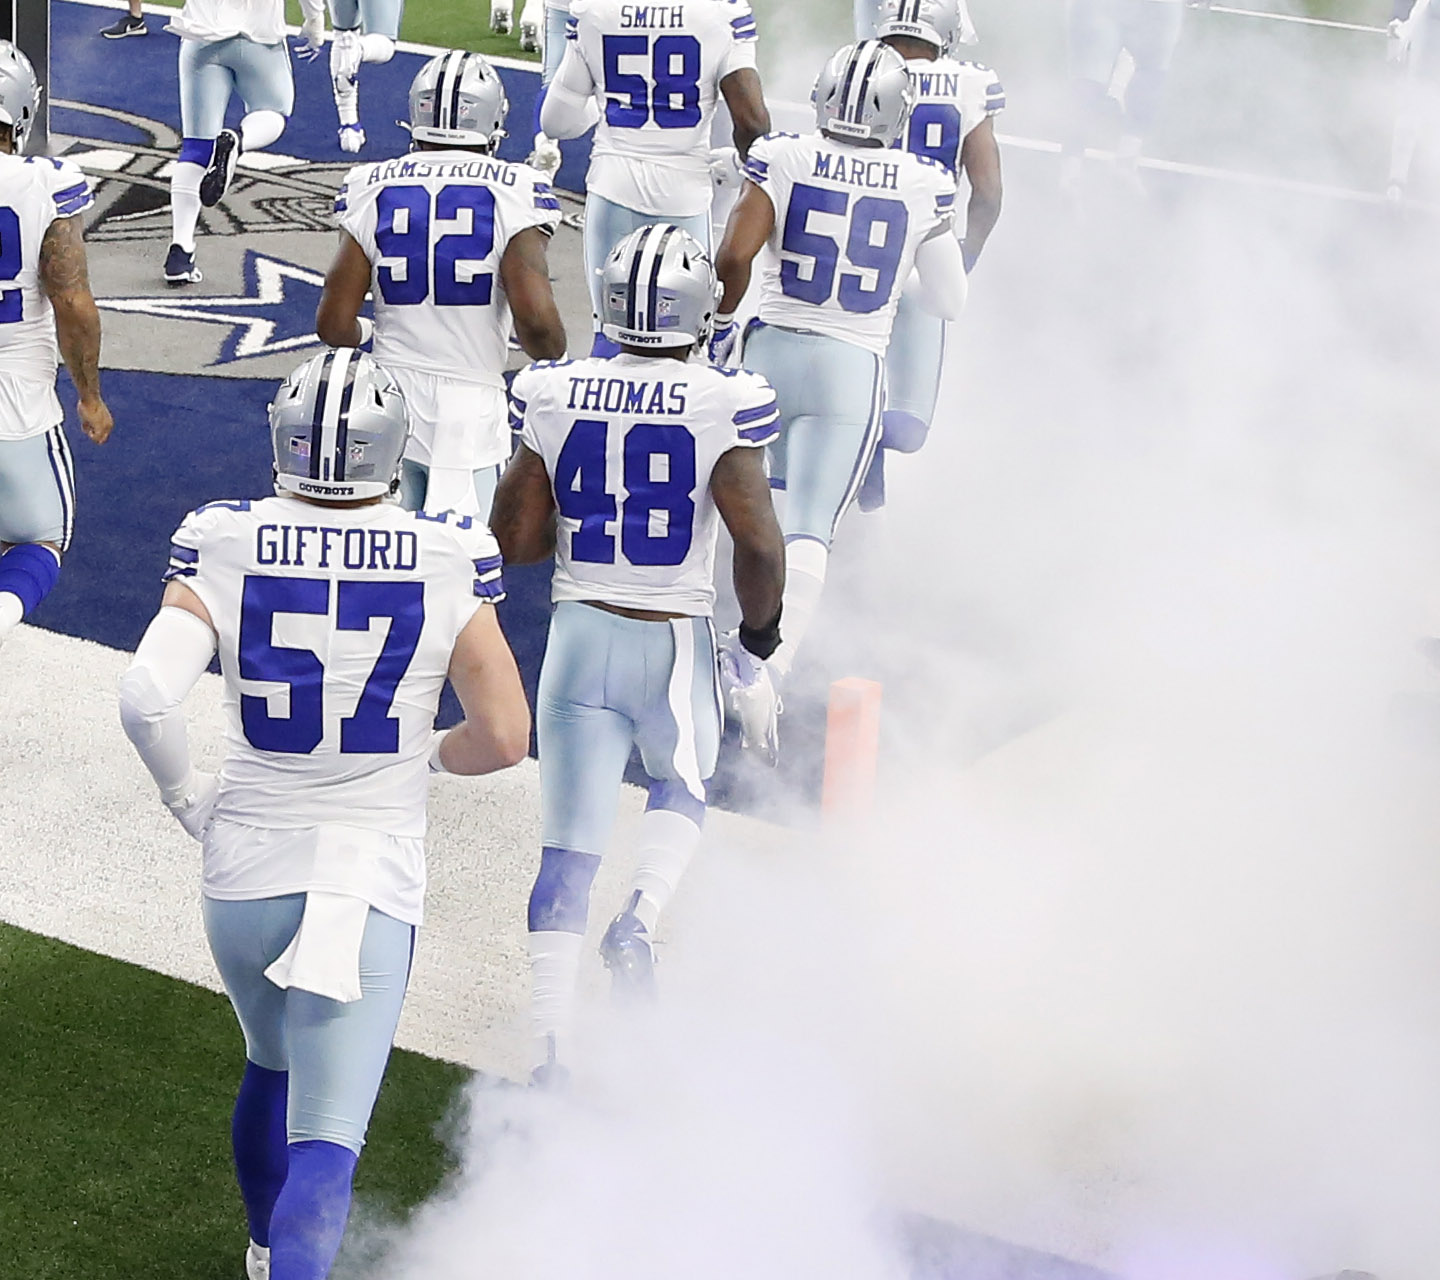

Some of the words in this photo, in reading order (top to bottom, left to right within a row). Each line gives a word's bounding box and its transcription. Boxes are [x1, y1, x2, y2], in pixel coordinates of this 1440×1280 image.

[620, 5, 684, 29] SMITH
[602, 34, 702, 129] 58
[366, 160, 517, 187] ARMSTRONG
[811, 151, 900, 191] MARCH
[375, 184, 497, 306] 92
[780, 182, 909, 314] 59
[566, 376, 688, 415] THOMAS
[298, 482, 355, 496] COWBOYS
[553, 419, 697, 567] 48
[255, 524, 418, 571] GIFFORD
[238, 574, 426, 755] 57
